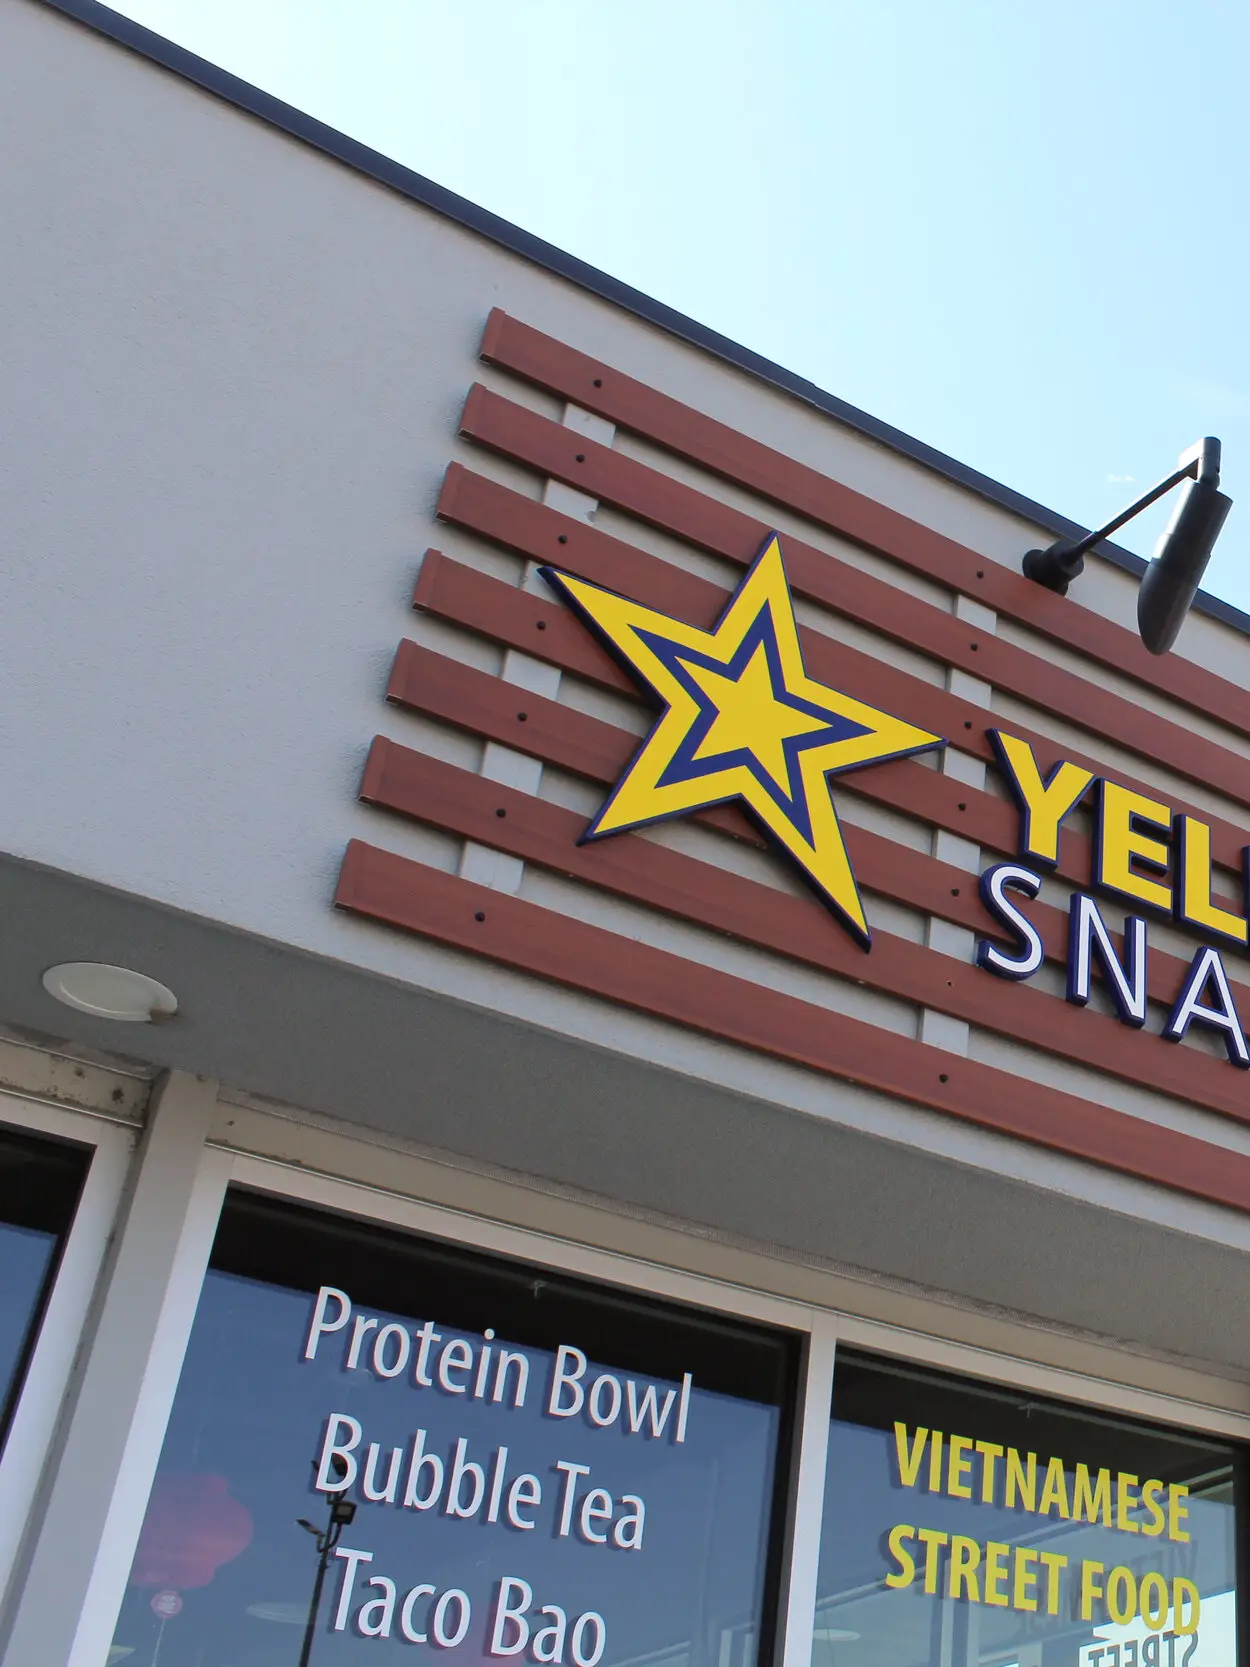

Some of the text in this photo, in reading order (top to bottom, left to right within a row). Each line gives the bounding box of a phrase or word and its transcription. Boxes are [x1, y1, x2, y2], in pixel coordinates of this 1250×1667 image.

[304, 1286, 692, 1443] Protein Bowl
[315, 1413, 646, 1550] Bubble Tea
[894, 1422, 1190, 1543] VIETNAMESE
[334, 1548, 606, 1667] Taco Bao
[885, 1524, 1067, 1616] STREET
[1081, 1560, 1201, 1636] FOOD
